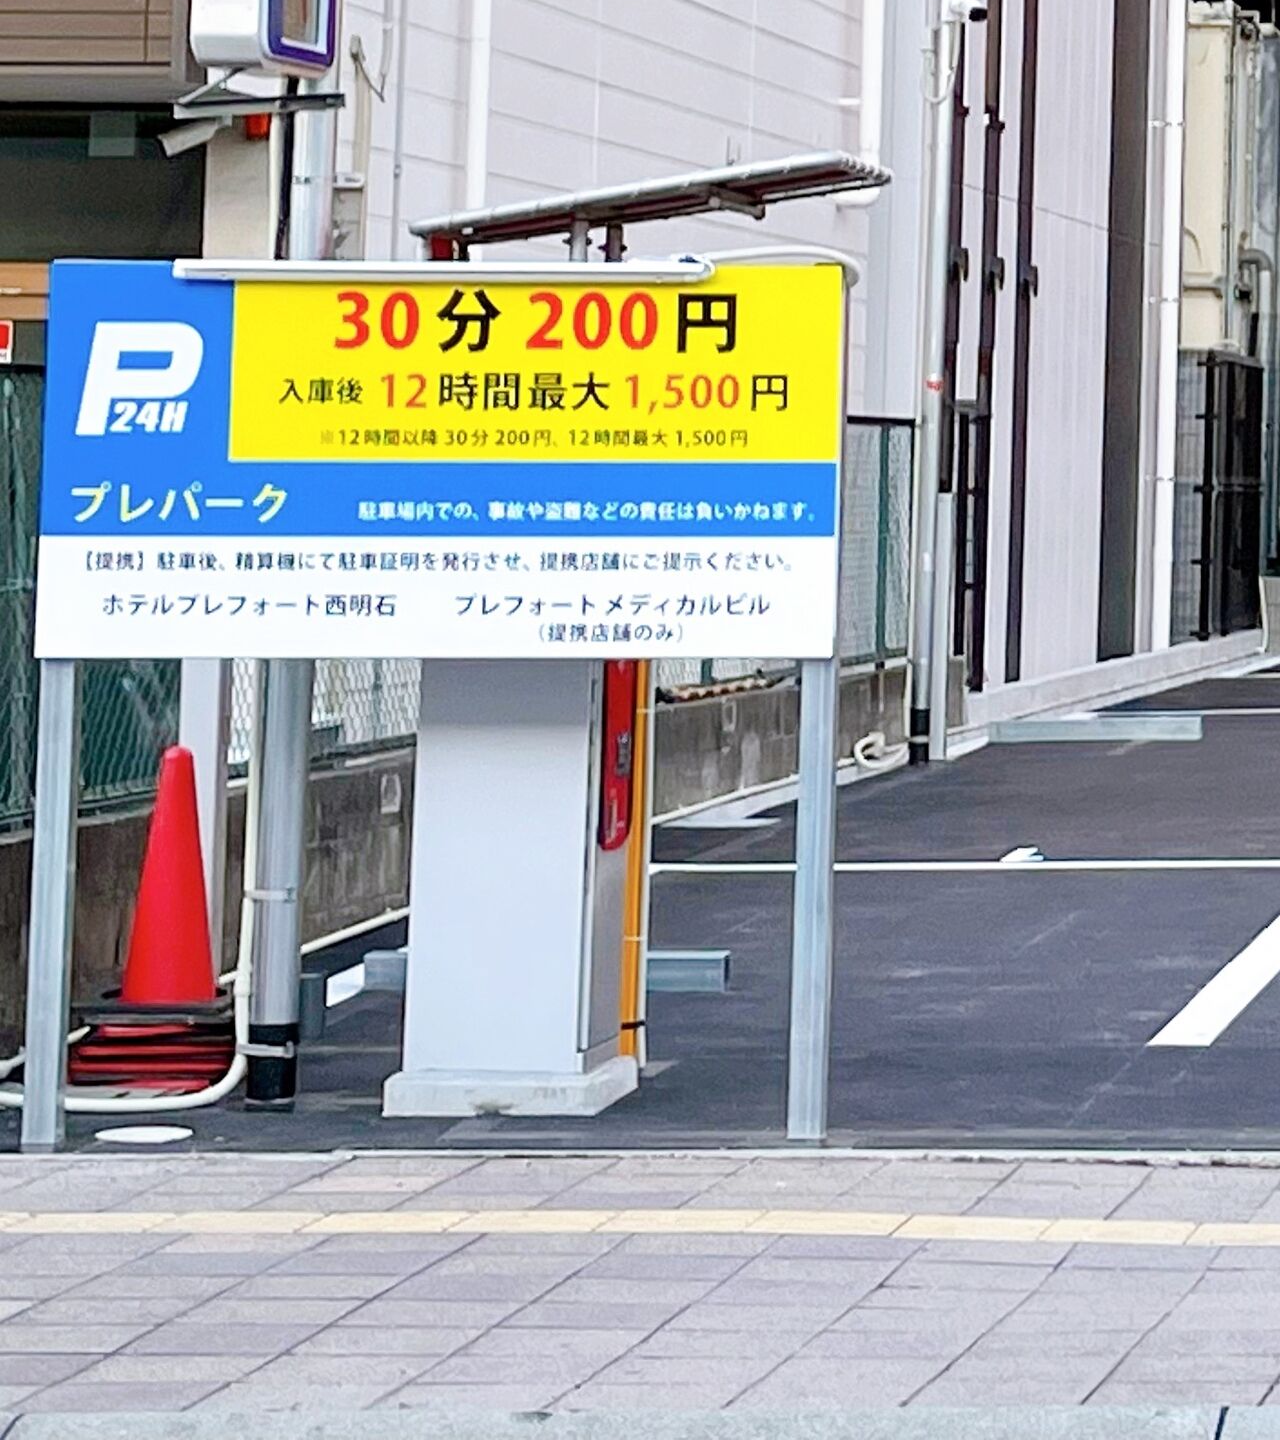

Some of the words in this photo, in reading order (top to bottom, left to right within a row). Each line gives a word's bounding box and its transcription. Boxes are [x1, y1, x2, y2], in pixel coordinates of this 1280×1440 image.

[75, 321, 204, 436] P
[109, 400, 189, 433] 24H
[71, 481, 289, 523] プレパーク
[102, 593, 398, 618] ホテルプレフォート西明石
